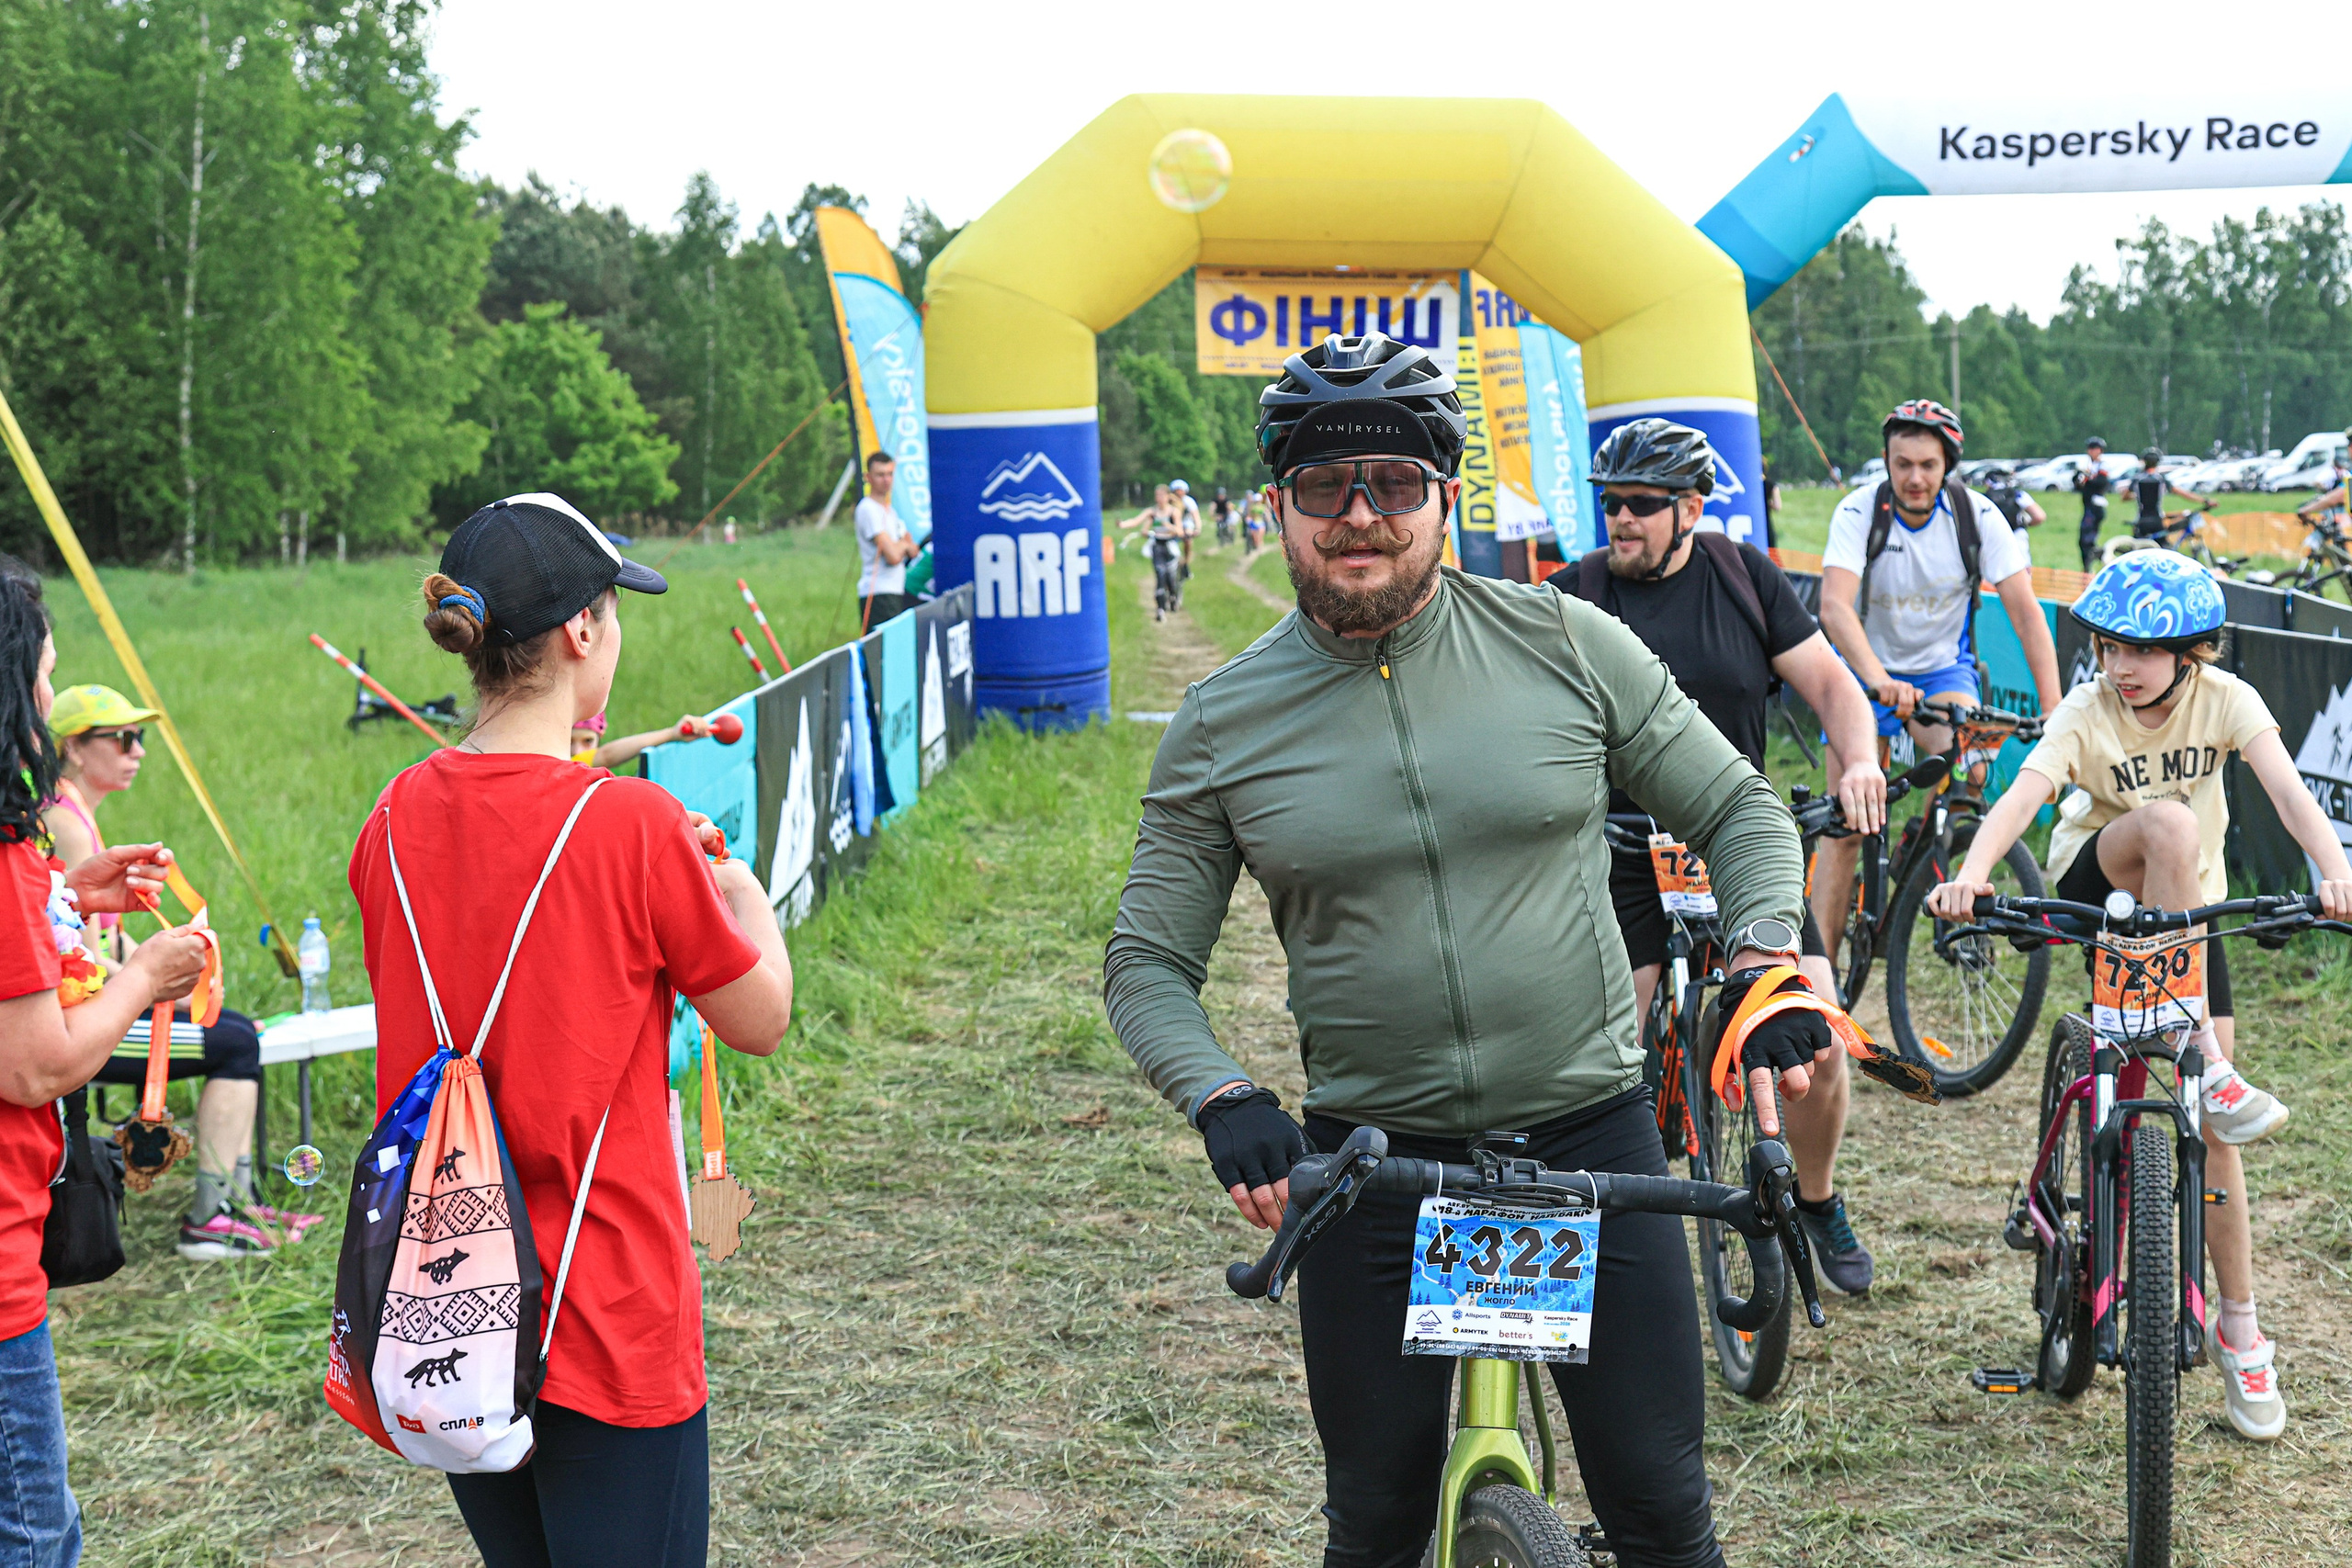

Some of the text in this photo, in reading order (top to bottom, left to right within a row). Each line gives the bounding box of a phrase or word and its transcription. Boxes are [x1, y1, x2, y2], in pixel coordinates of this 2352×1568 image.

[1940, 117, 2321, 167] Kaspersky Race
[973, 528, 1091, 618] ARF
[1464, 1208, 1525, 1220] МАРАФОН
[1305, 1204, 1338, 1241] GRX
[1425, 1223, 1586, 1281] 4322
[1465, 1280, 1535, 1296] ЕВГЕНИЙ
[1484, 1297, 1516, 1305] ЖОГЛО
[1464, 1312, 1491, 1320] Allsports
[1498, 1329, 1533, 1340] better's
[439, 1416, 485, 1431] СПЛАВ
